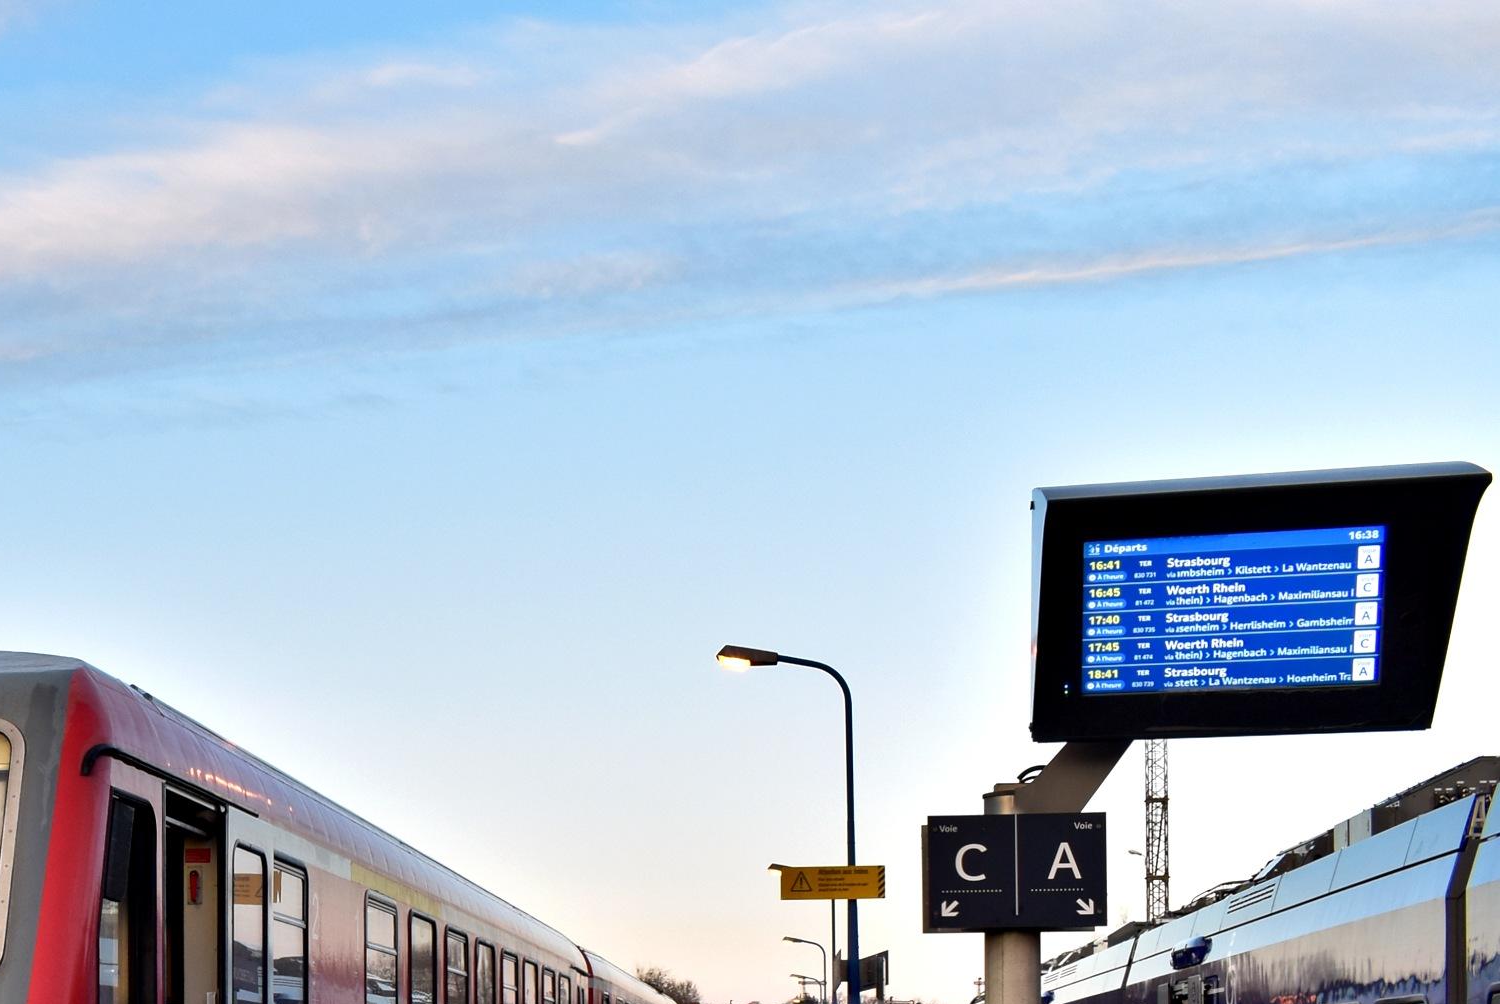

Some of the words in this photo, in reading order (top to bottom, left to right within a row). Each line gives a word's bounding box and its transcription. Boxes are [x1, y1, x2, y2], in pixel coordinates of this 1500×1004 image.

[1349, 530, 1379, 540] 16:38
[1104, 543, 1148, 554] Départs
[1167, 557, 1231, 568] Strasbourg
[1364, 555, 1373, 564] A
[1089, 560, 1120, 571] 16:41
[1235, 565, 1272, 575] Kilstett
[1283, 564, 1293, 572] La
[1296, 562, 1352, 572] Wantzenau
[1166, 585, 1209, 595] Woerth
[1213, 583, 1246, 593] Rhein
[1363, 582, 1372, 592] C
[1089, 588, 1120, 598] 16:45
[1214, 593, 1268, 605] Hagenbach
[1278, 590, 1349, 601] Maximiliansau
[1089, 615, 1120, 625] 17:40
[1165, 612, 1229, 623] Strasbourg
[1362, 611, 1370, 620] A
[1230, 619, 1286, 630] Herrlisheim
[1088, 642, 1120, 652] 17:45
[1165, 640, 1208, 650] Woerth
[1211, 638, 1244, 648] Rhein
[1360, 638, 1370, 649] C
[1213, 648, 1267, 660] Hagenbach
[1277, 646, 1347, 656] Maximiliansau
[1088, 669, 1118, 679] 18:41
[1164, 667, 1228, 678] Strasbourg
[1359, 667, 1368, 677] A
[1209, 678, 1220, 686] La
[1222, 676, 1276, 685] Wantzenau
[1287, 674, 1337, 683] Hoenheim
[939, 824, 958, 833] Voie
[1074, 821, 1093, 830] Voie
[955, 843, 988, 881] C
[1047, 842, 1082, 879] A
